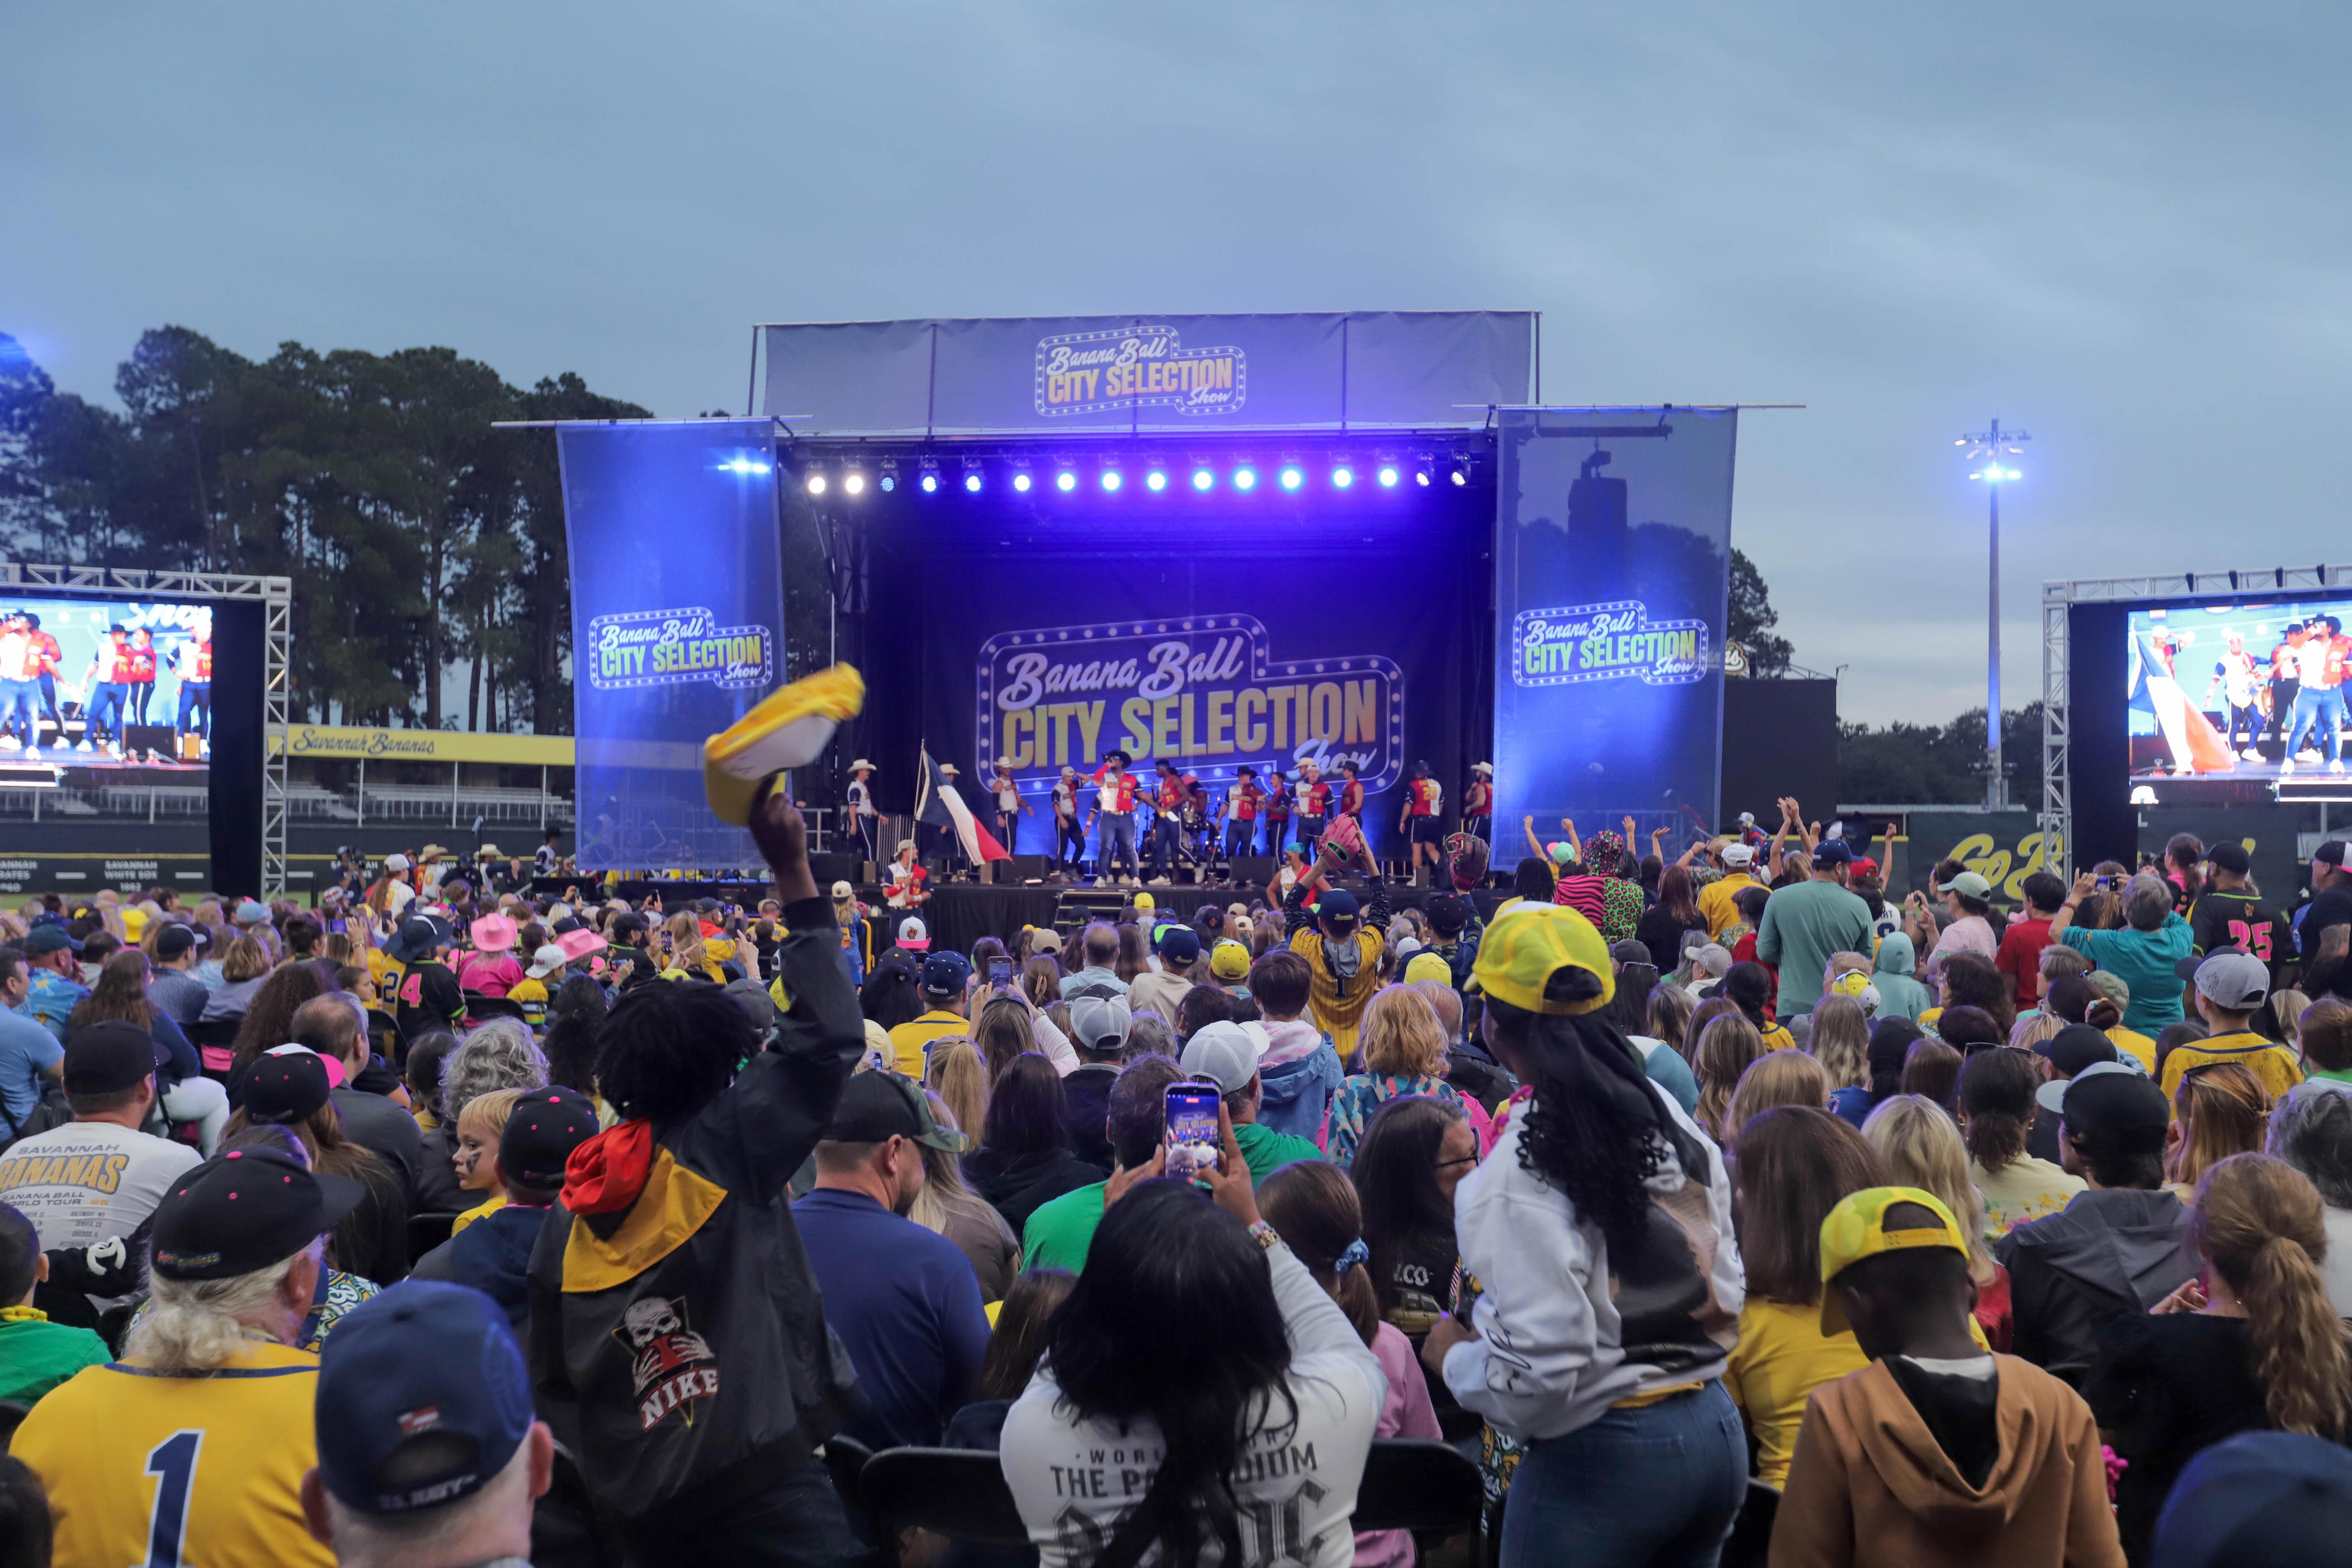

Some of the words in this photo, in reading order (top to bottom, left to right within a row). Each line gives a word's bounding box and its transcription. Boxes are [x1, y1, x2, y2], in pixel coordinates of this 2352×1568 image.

[1046, 346, 1117, 375] Banana
[1116, 337, 1167, 367] Ball
[1048, 368, 1100, 404] CITY
[1106, 358, 1231, 396] SELECTION
[1187, 386, 1232, 406] Show
[599, 625, 660, 651] Banana
[660, 617, 704, 645] Ball
[1523, 620, 1589, 648] Banana
[1588, 611, 1635, 641] Ball
[602, 645, 645, 677] CITY
[653, 635, 761, 673] SELECTION
[1526, 641, 1574, 674] CITY
[1580, 630, 1695, 669] SELECTION
[1653, 657, 1695, 676] Show
[724, 662, 762, 680] Show
[998, 652, 1140, 711] Banana
[1138, 635, 1244, 701] Ball
[294, 728, 368, 752] Savannah
[367, 733, 434, 755] Bananas
[1003, 699, 1106, 770] CITY
[1120, 679, 1377, 761] SELECTION
[1286, 738, 1377, 780] Show
[105, 870, 136, 880] WHITE
[138, 870, 158, 880] SOX
[2228, 919, 2273, 962] 25
[400, 973, 422, 1008] 4
[18, 1145, 120, 1154] SAVANNAH
[0, 1154, 130, 1195] BANANAS
[641, 1369, 717, 1429] NIKE
[1050, 1466, 1108, 1498] THE
